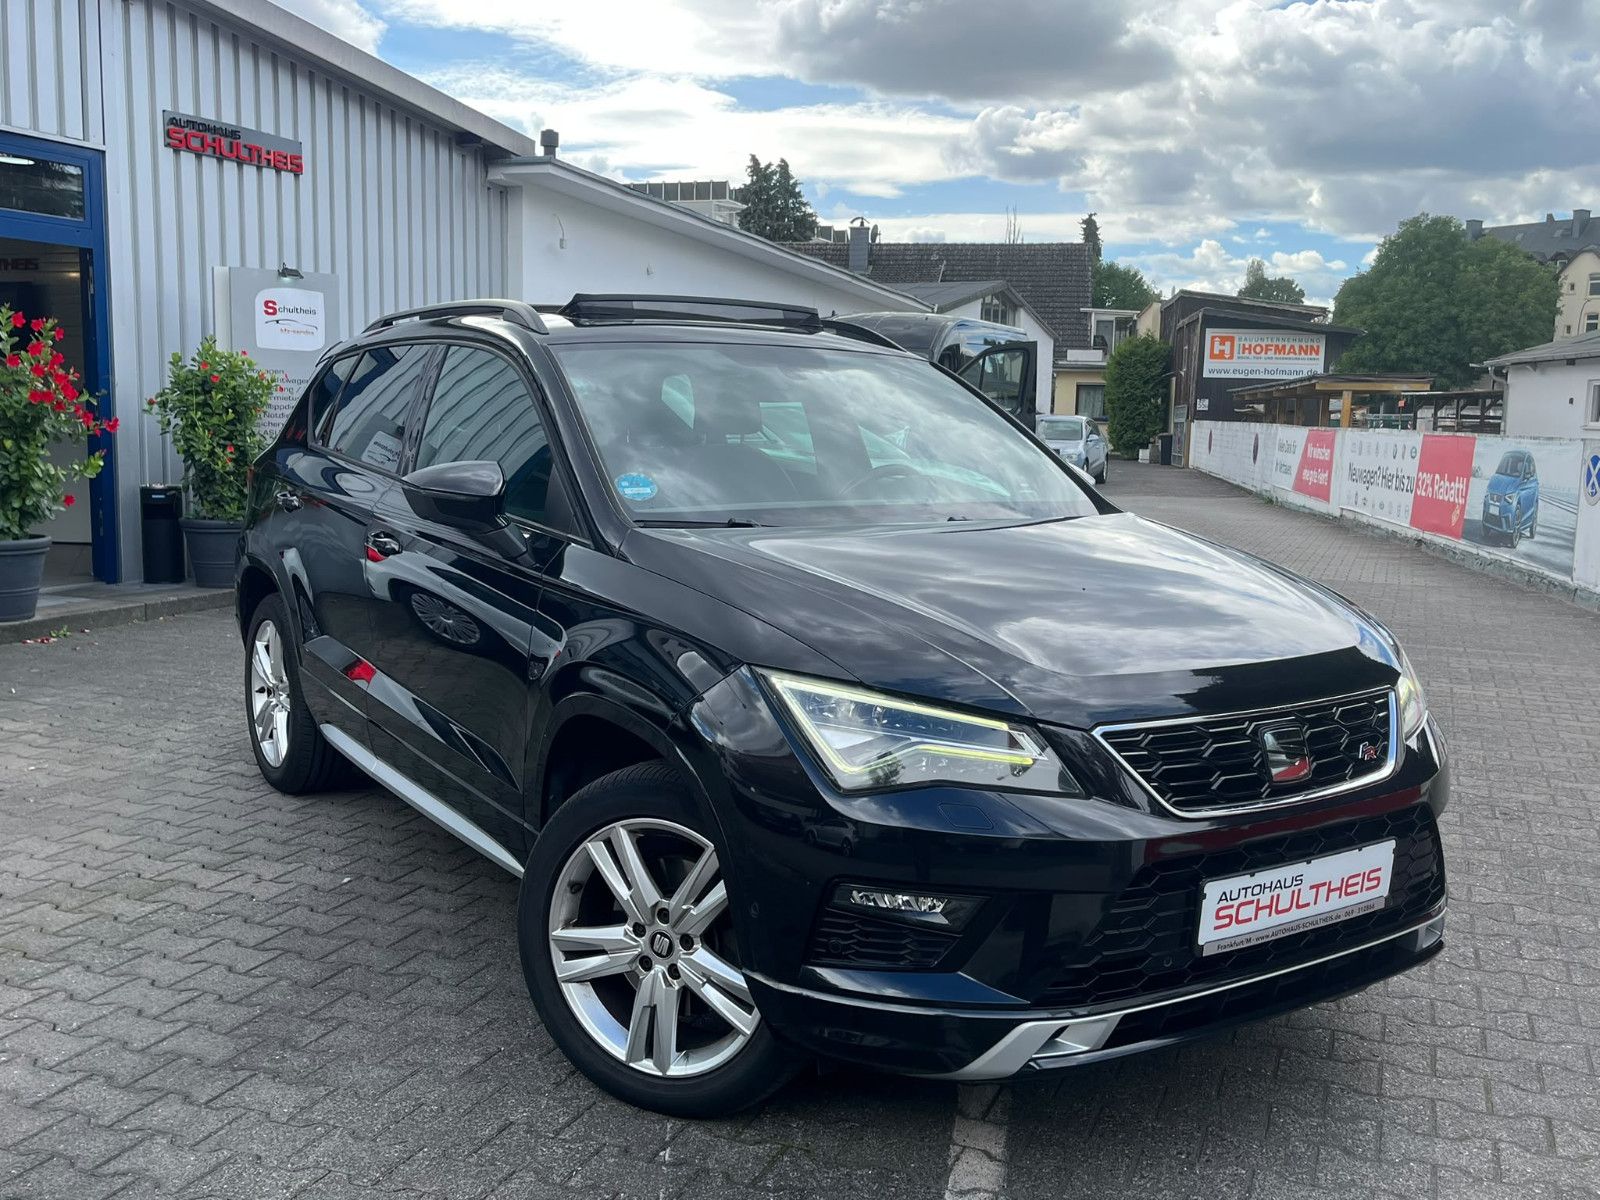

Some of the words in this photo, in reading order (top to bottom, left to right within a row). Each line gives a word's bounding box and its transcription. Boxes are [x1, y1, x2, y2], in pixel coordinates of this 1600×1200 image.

[167, 116, 242, 140] AUTOHAUS
[167, 127, 304, 175] SCHULTHEIS
[263, 300, 316, 316] Schultheis
[1241, 343, 1320, 356] HOFMANN
[1208, 367, 1319, 377] www.eugen-hofmann.de
[1348, 462, 1381, 491] Neuwagen?
[1381, 464, 1395, 490] Hier
[1395, 468, 1405, 492] bis
[1405, 475, 1415, 494] zu
[1416, 472, 1433, 498] 32%
[1433, 473, 1467, 505] Rabatt!
[1213, 867, 1382, 931] SCHULTHEIS
[1217, 874, 1304, 904] AUTOHAUS
[1255, 913, 1341, 942] www.AUTOHAUS-SCHULTHEIS.de
